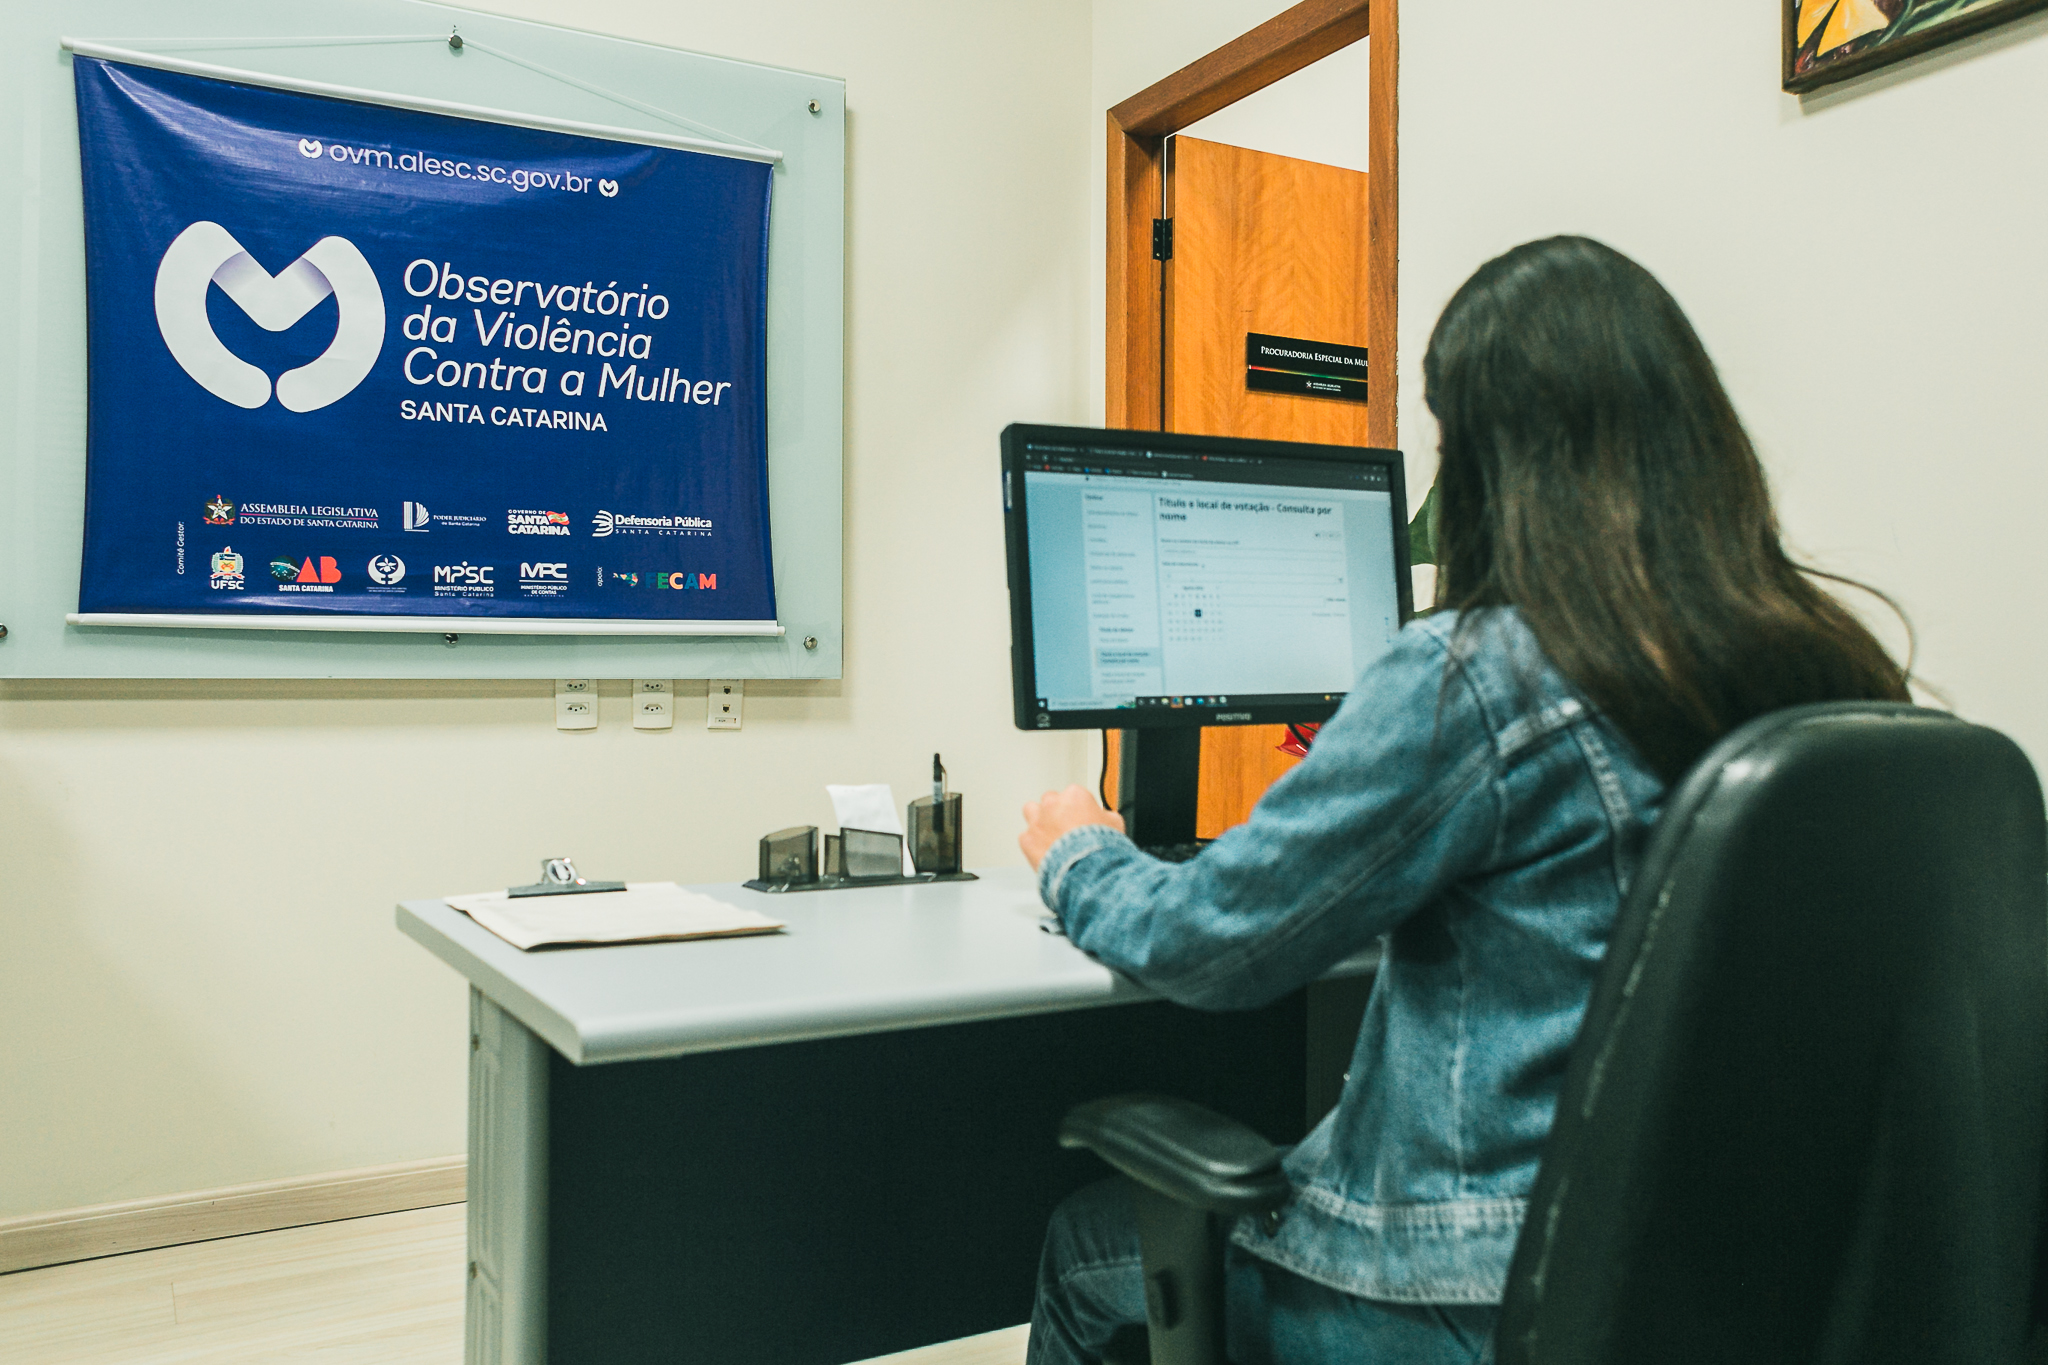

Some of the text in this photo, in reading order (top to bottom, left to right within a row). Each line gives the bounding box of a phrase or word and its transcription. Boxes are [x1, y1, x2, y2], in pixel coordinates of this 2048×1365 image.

[329, 143, 593, 194] ovm.alesc.sc.gov.br
[403, 259, 669, 319] Observatório
[403, 304, 652, 359] da Violência
[1260, 346, 1314, 360] PROCURADORIA
[1314, 352, 1342, 364] ESPECIAL
[1344, 357, 1353, 365] DA
[404, 347, 731, 405] Contra a Mulher
[401, 400, 608, 431] SANTA CATARINA
[240, 503, 379, 518] ASSEMBLEIA LEGISLATIVA
[1220, 500, 1232, 510] de
[1234, 502, 1269, 513] votação
[1276, 503, 1315, 514] Consulta
[1317, 507, 1332, 516] por
[240, 516, 379, 529] DO ESTADO DE SANTA CATARINA
[507, 515, 549, 526] SANTA
[615, 514, 712, 528] Defensoria Pública
[507, 525, 571, 536] CATARINA
[176, 547, 185, 575] Comitê
[434, 565, 494, 584] MPSC
[520, 562, 567, 578] MPC
[211, 579, 244, 590] UFSC
[278, 584, 333, 593] SANTA CATARINA
[645, 572, 717, 590] FECAM
